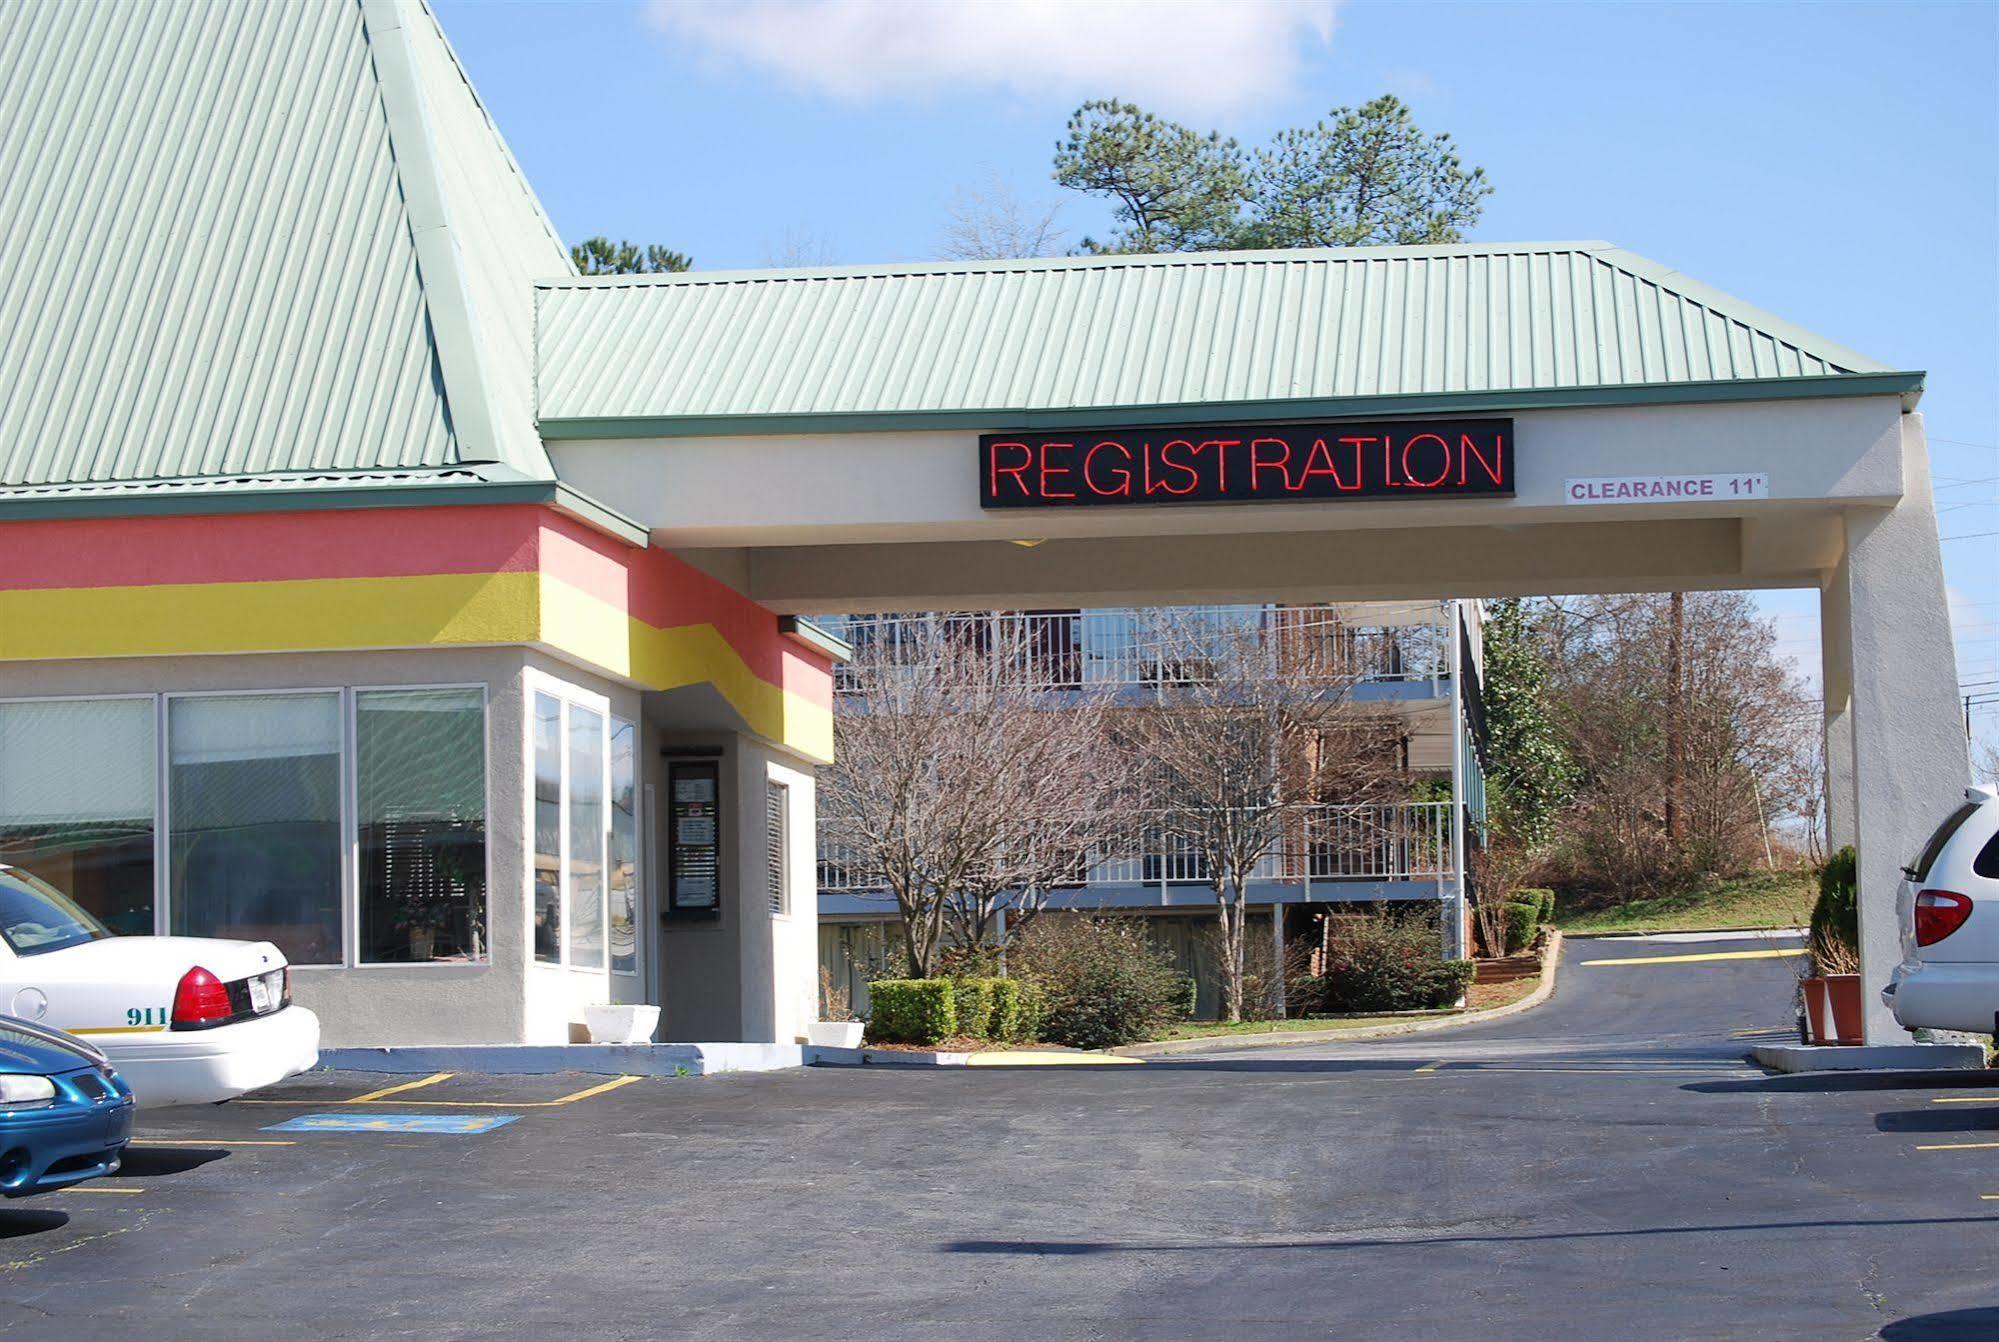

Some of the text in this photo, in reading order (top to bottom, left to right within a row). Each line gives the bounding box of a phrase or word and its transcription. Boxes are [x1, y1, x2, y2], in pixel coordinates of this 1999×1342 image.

[990, 433, 1503, 498] REGISTRATION
[1570, 478, 1761, 500] CLEARANCE 11'
[127, 1007, 167, 1026] 911
